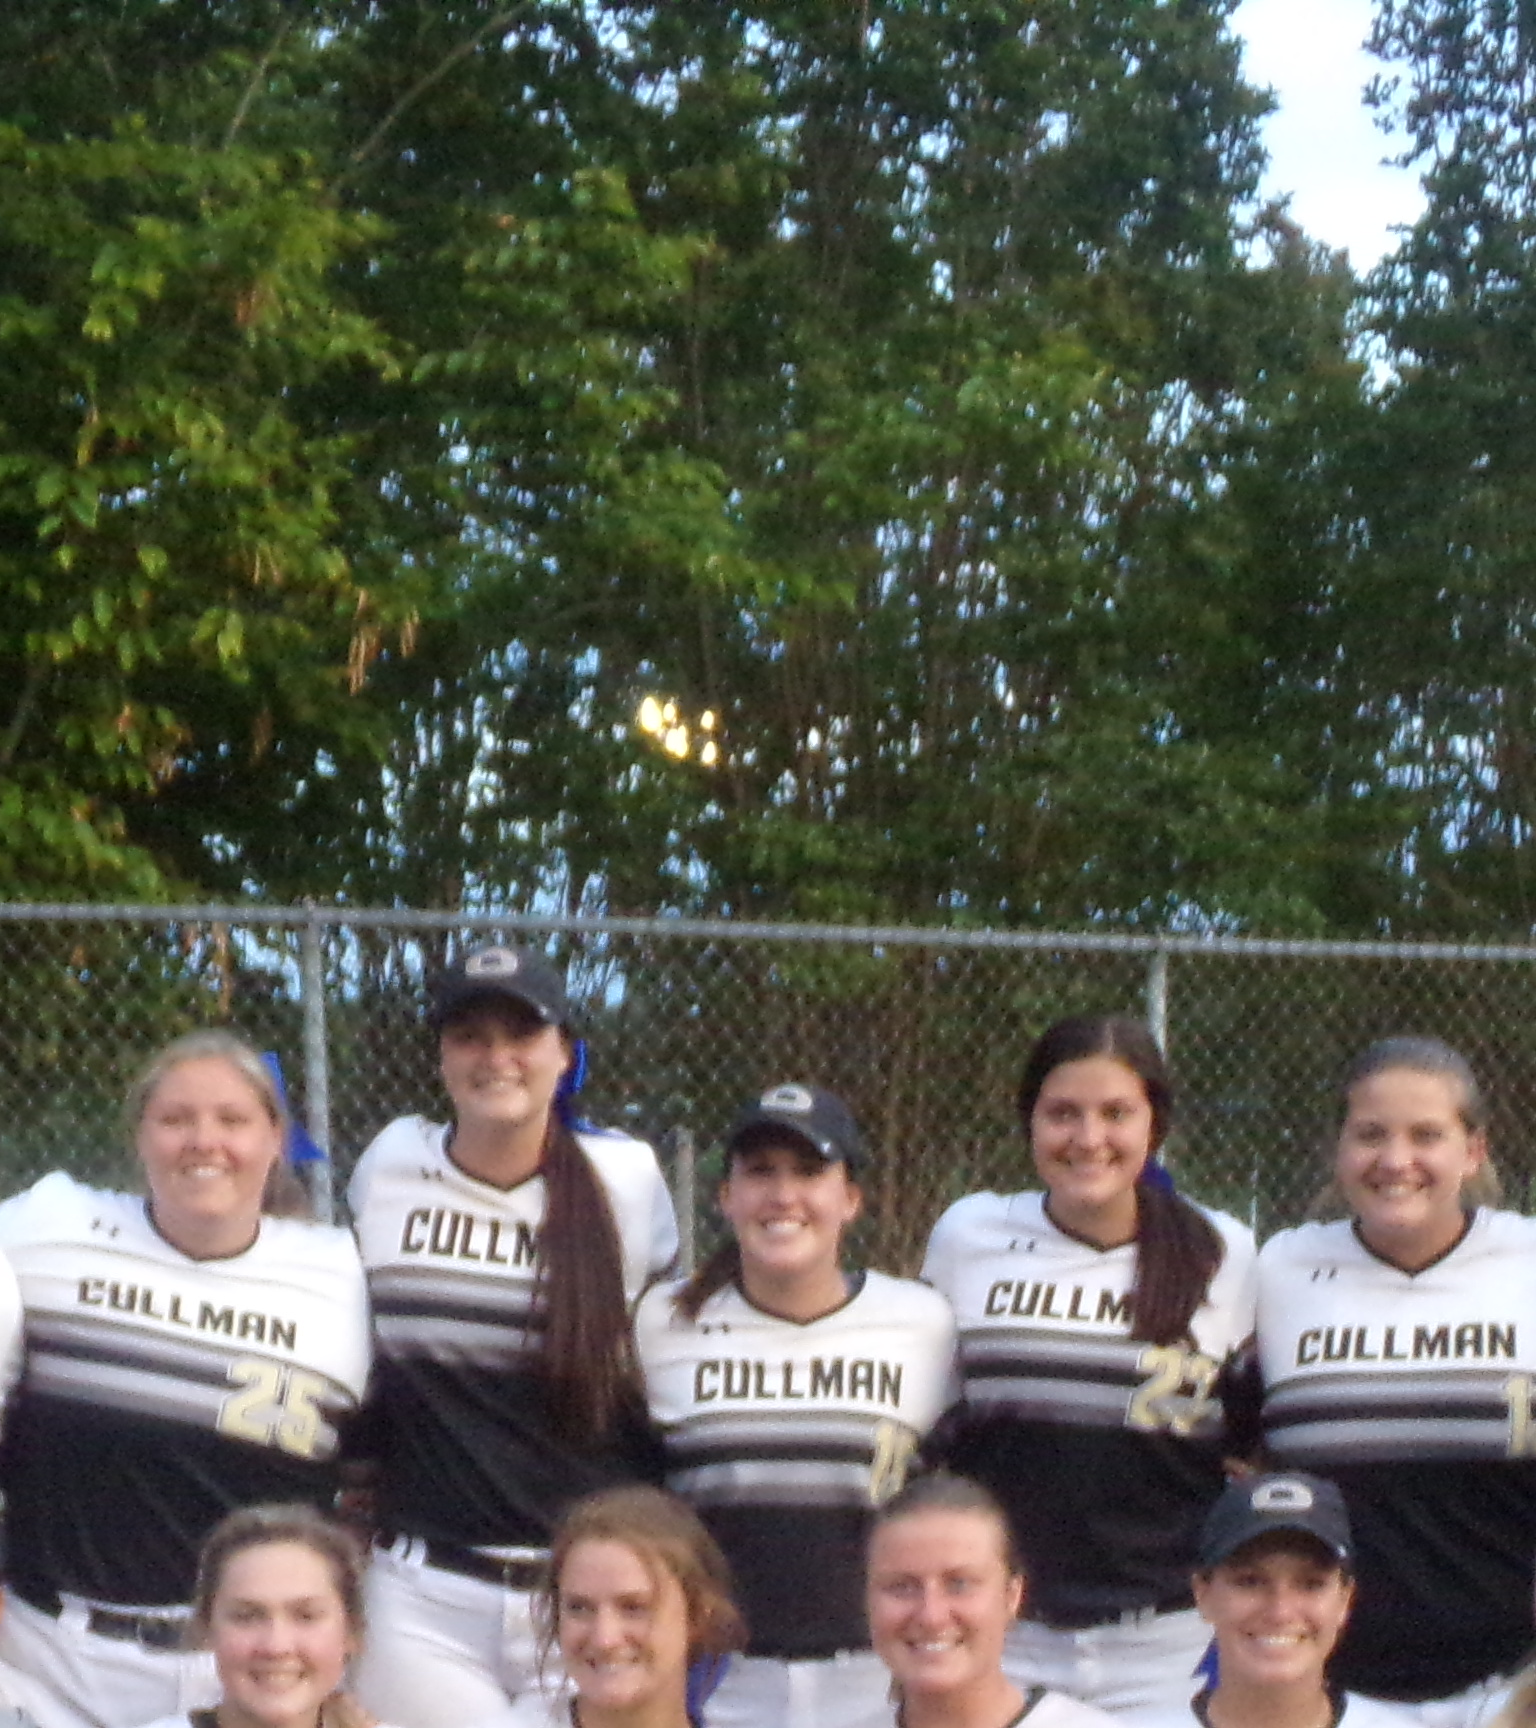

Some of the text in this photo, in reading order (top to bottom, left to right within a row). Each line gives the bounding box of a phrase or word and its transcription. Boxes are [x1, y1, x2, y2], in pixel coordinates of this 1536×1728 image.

[401, 1207, 537, 1270] CULLM
[78, 1278, 297, 1351] CULLMAN
[984, 1280, 1133, 1324] CULLM
[1296, 1322, 1517, 1364] CULLMAN
[215, 1360, 339, 1461] 25
[693, 1356, 904, 1409] CULLMAN
